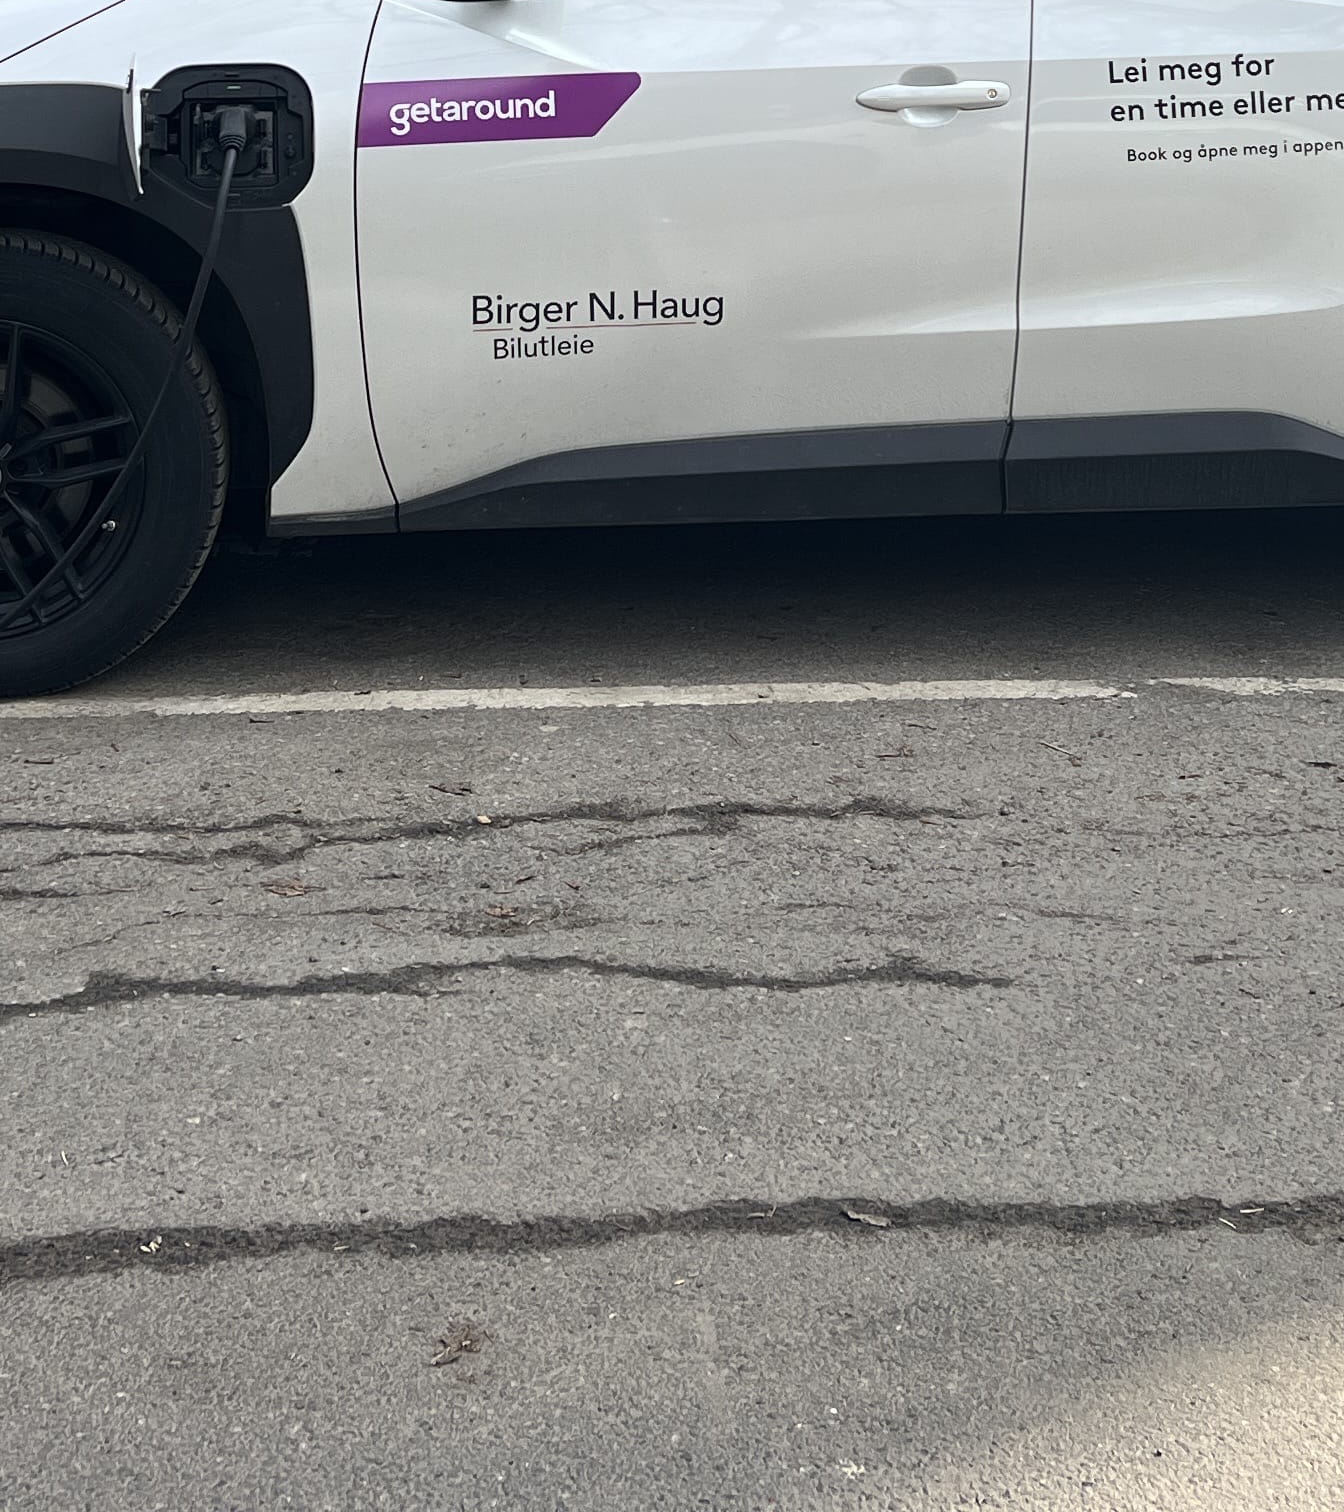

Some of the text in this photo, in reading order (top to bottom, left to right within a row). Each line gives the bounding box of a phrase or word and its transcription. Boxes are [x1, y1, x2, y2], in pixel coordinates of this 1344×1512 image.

[1108, 53, 1275, 86] Lei meg for
[389, 90, 556, 136] getaround
[1110, 102, 1145, 122] en
[1154, 94, 1224, 119] time
[1233, 90, 1295, 115] eller
[1127, 144, 1168, 163] Book
[1172, 147, 1192, 163] og
[1197, 143, 1238, 162] åpne
[1243, 141, 1278, 158] meg
[1292, 139, 1344, 157] appen
[472, 290, 724, 332] Birger N. Haug
[493, 334, 595, 360] Bilutleie
